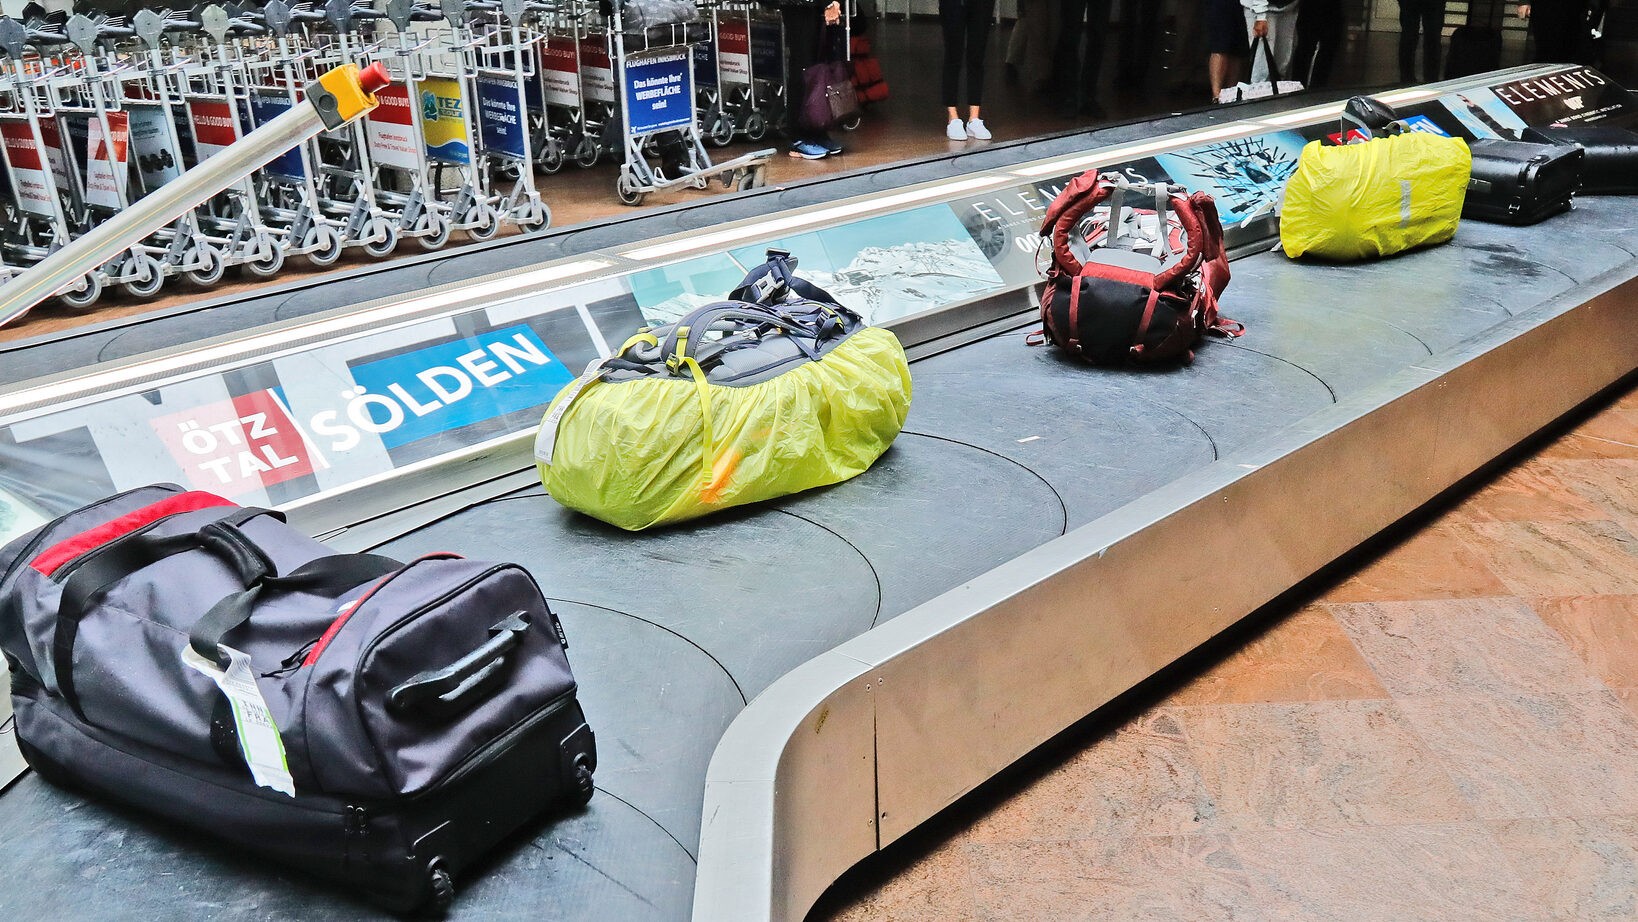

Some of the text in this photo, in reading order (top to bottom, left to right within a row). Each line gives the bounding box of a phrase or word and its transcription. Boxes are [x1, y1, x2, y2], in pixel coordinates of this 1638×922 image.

[626, 58, 657, 68] FLUGHAFEN
[657, 53, 686, 63] INNSBRUCK
[633, 79, 646, 89] Das
[646, 76, 668, 87] könnte
[635, 85, 681, 101] WERBEFLÄCHE
[1495, 69, 1605, 106] ELEMENTS
[436, 96, 462, 110] TEZ
[310, 332, 553, 452] SÖLDEN
[177, 411, 278, 455] ÖTZ
[199, 443, 300, 485] TAL
